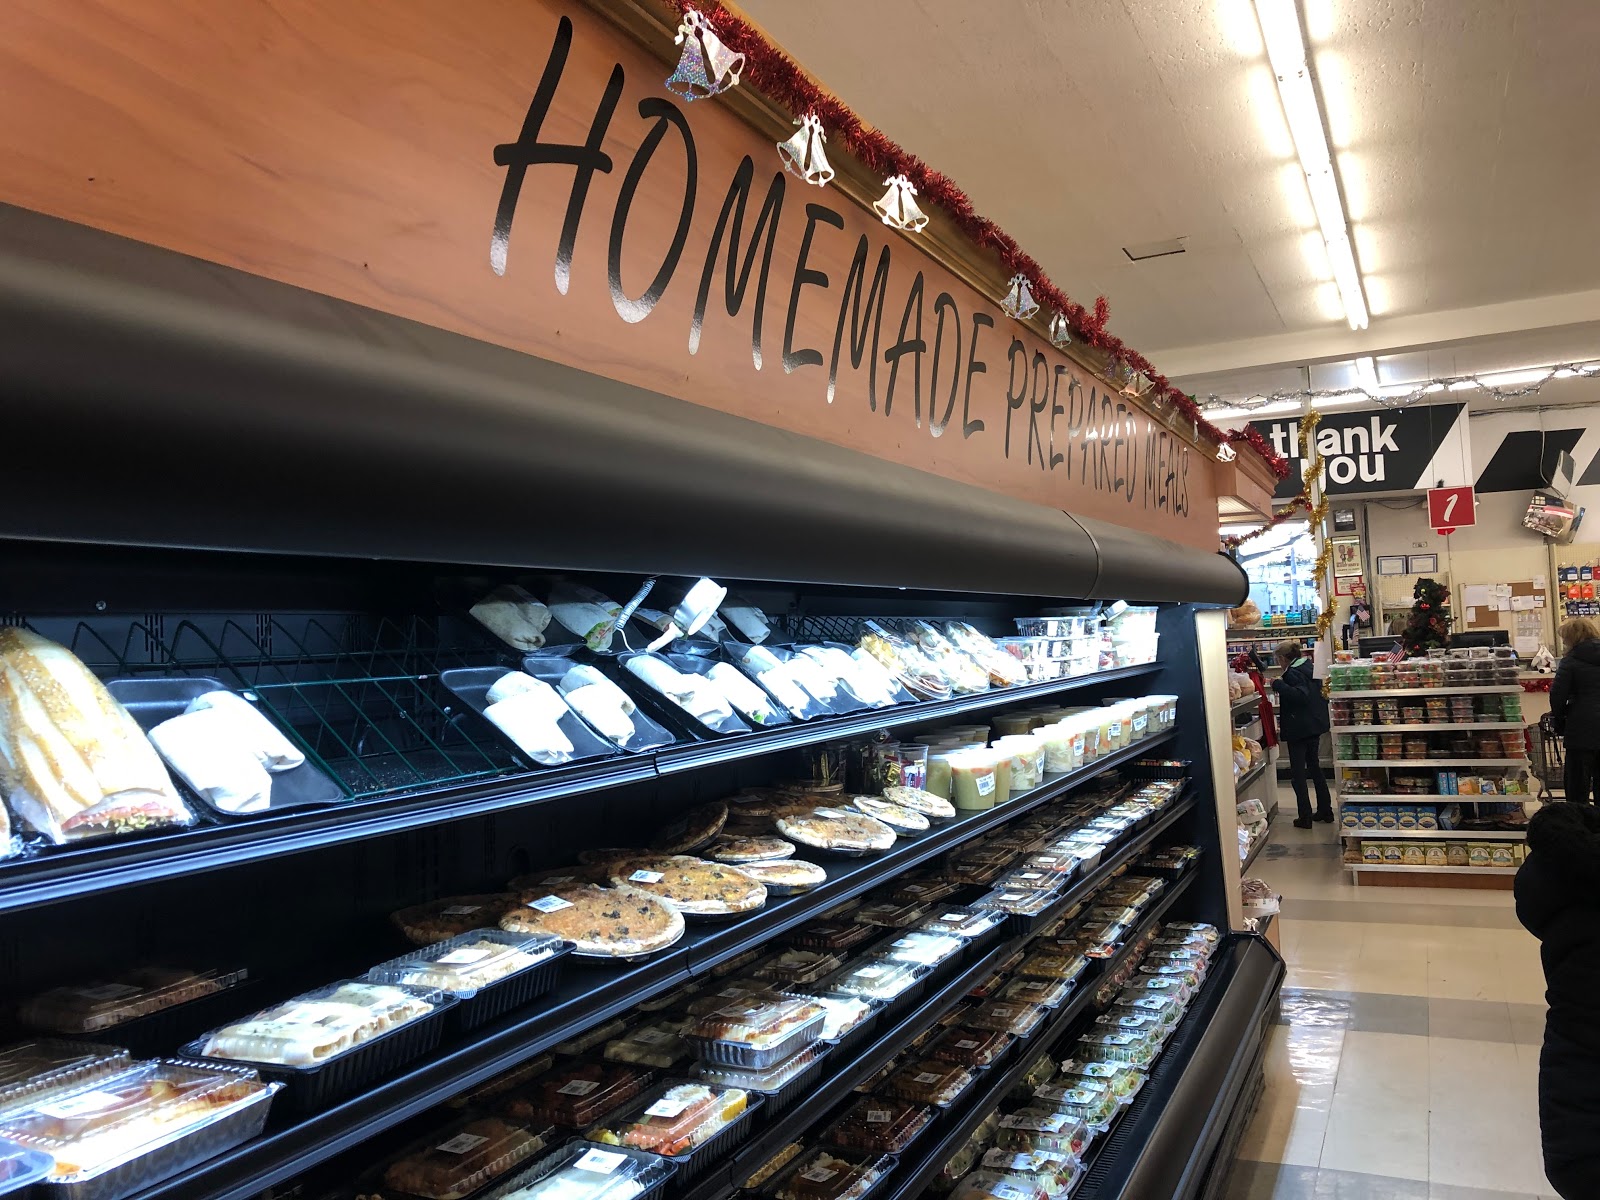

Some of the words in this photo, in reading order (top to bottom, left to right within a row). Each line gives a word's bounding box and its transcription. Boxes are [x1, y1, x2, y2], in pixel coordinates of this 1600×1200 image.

[490, 15, 994, 439] HOMEMADE
[1004, 335, 1137, 503] PREPARED
[1144, 422, 1189, 518] MEALS
[1269, 416, 1400, 459] thank
[1443, 493, 1459, 522] 1
